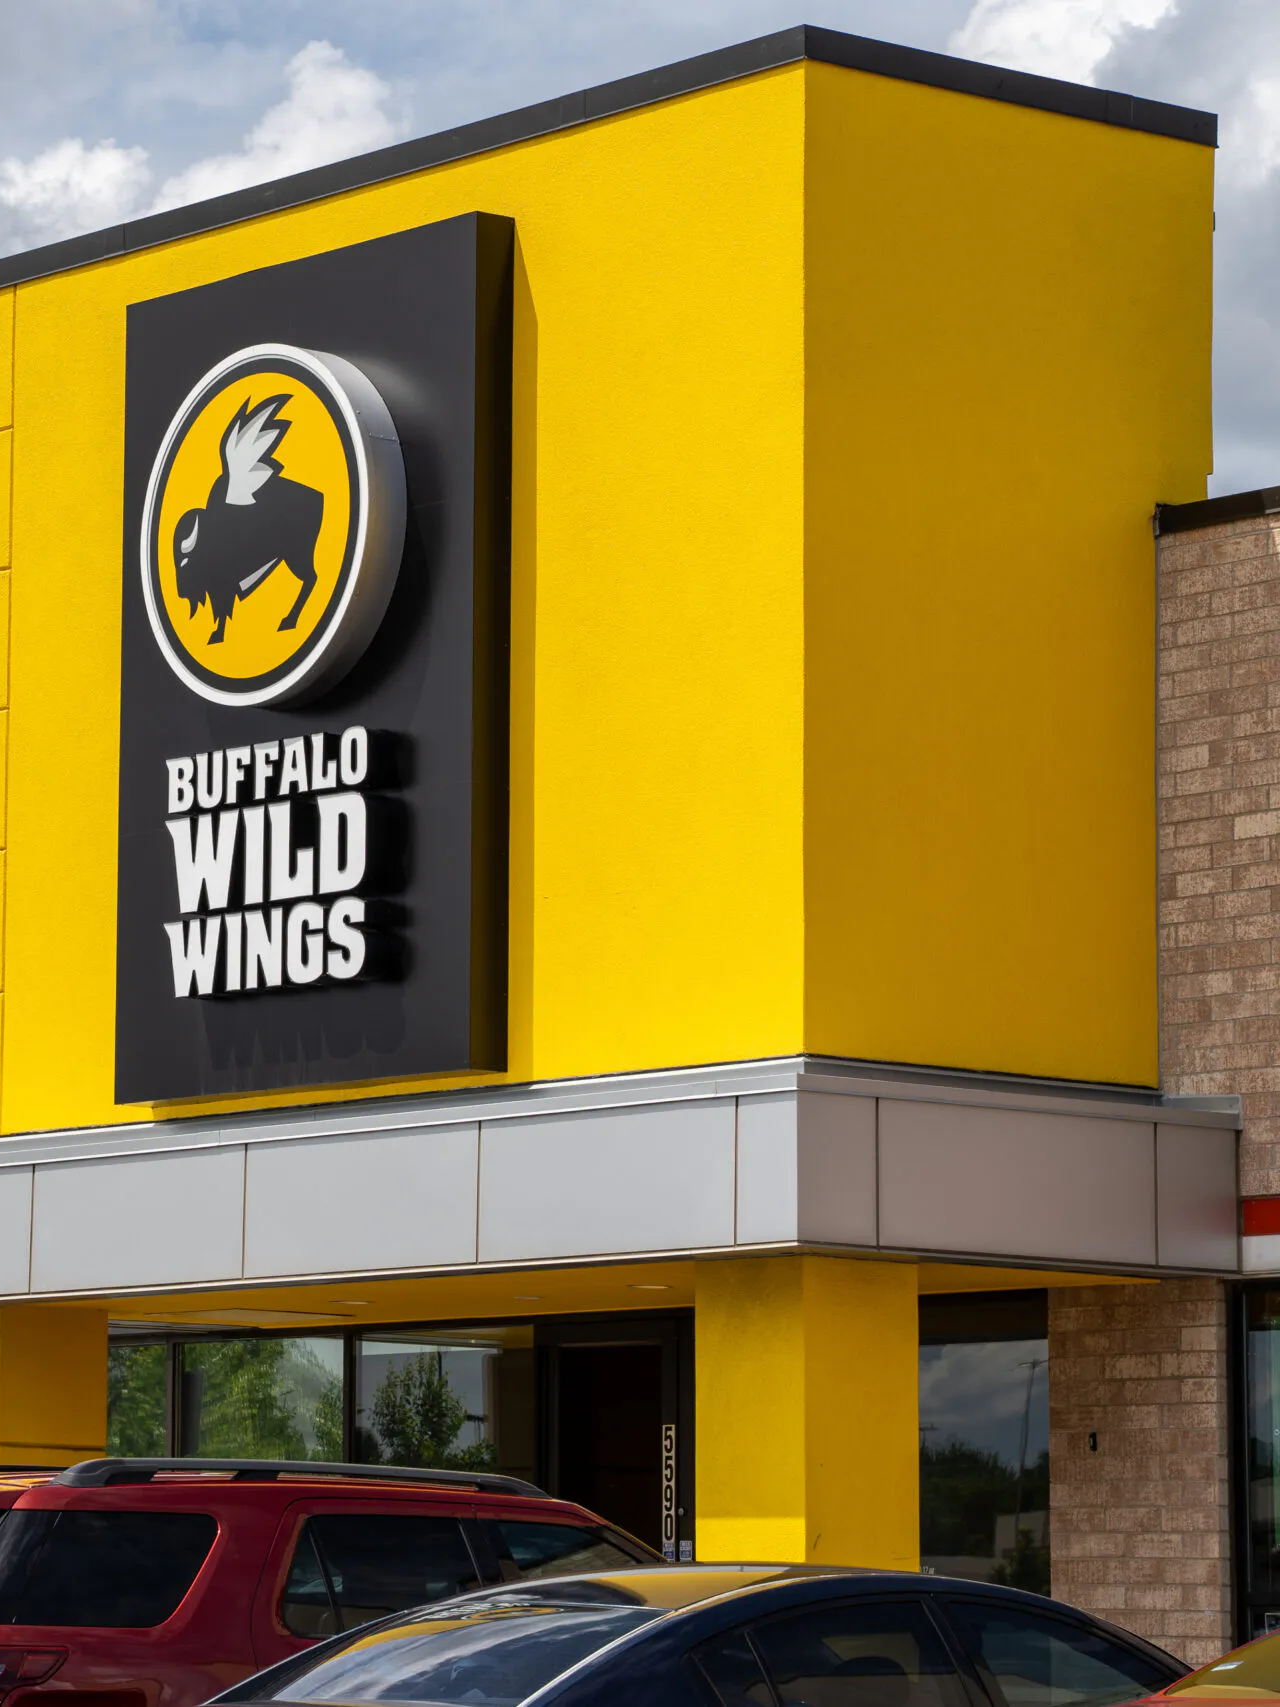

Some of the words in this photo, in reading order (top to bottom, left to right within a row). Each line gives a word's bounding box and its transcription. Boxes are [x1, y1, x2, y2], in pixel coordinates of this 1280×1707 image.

[166, 726, 367, 813] BUFFALO
[165, 791, 367, 913] WILD
[164, 896, 367, 998] WINGS
[664, 1426, 673, 1541] 5590
